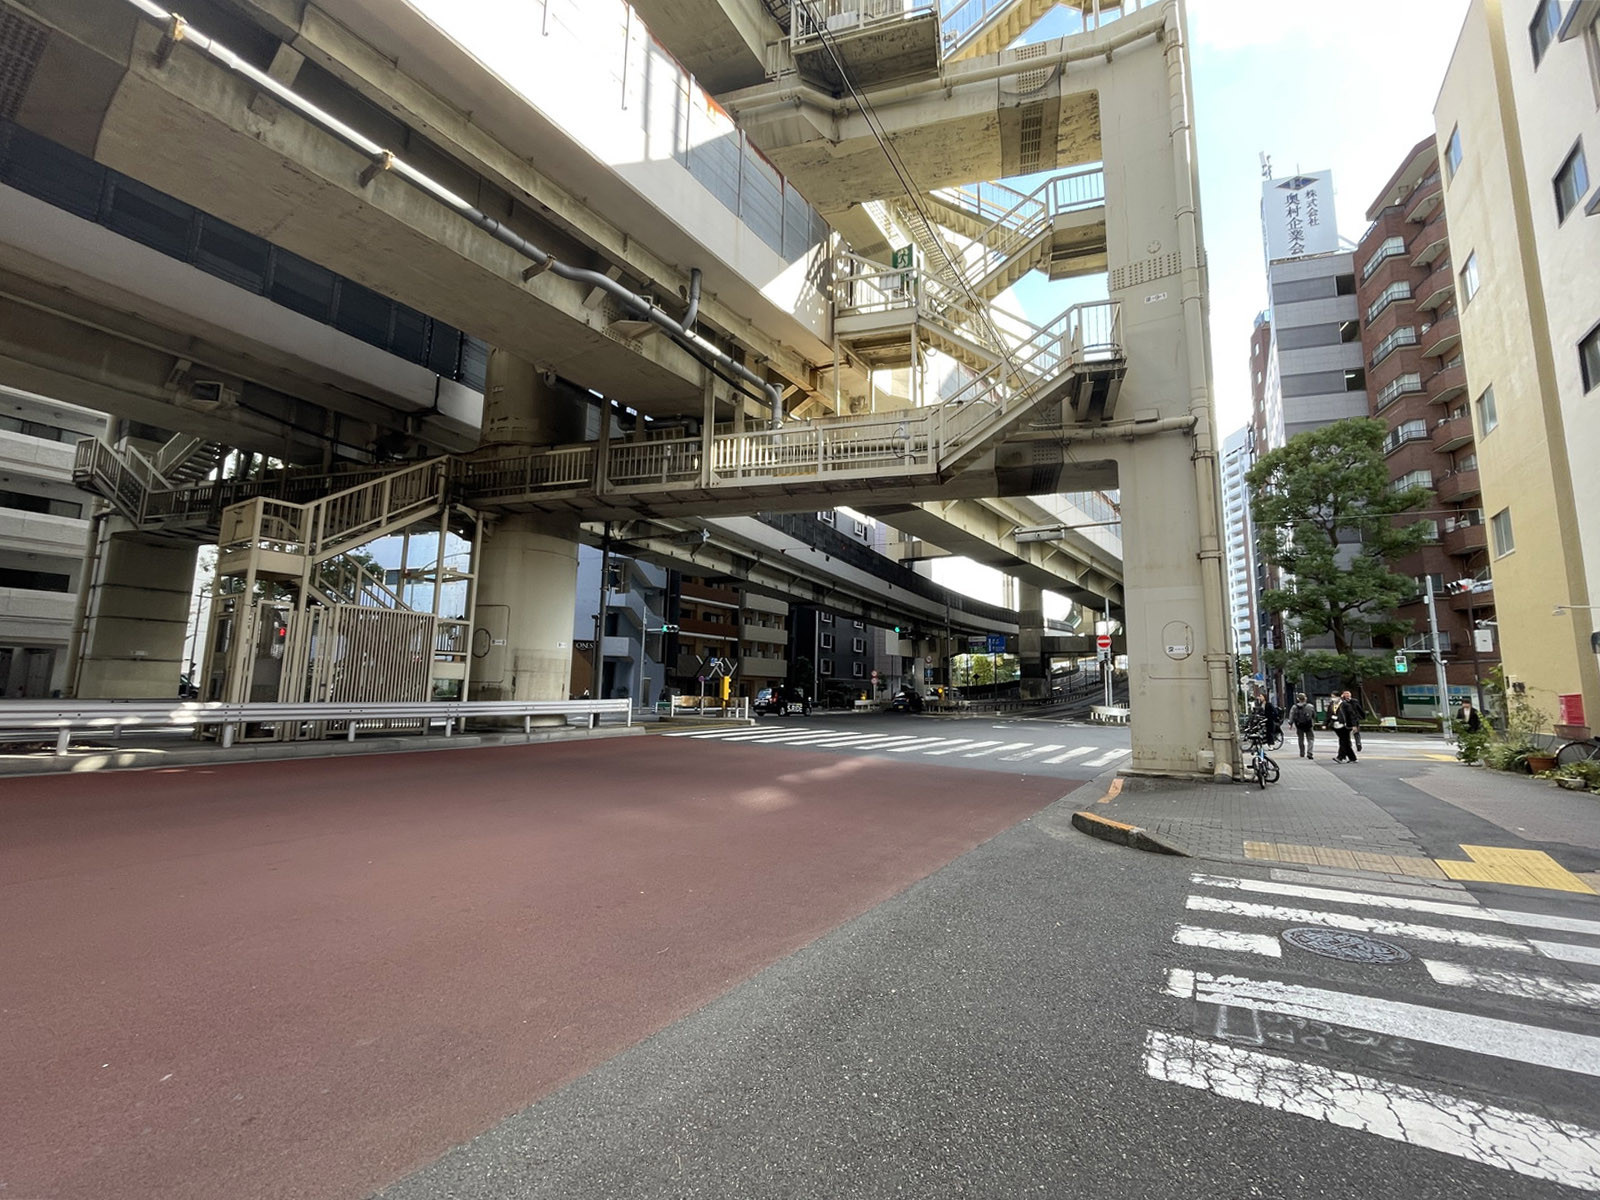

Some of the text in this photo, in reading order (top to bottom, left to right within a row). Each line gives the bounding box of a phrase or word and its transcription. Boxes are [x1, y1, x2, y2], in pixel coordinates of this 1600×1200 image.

[1285, 192, 1305, 255] 奥村企業会
[1305, 189, 1320, 227] 株式会社
